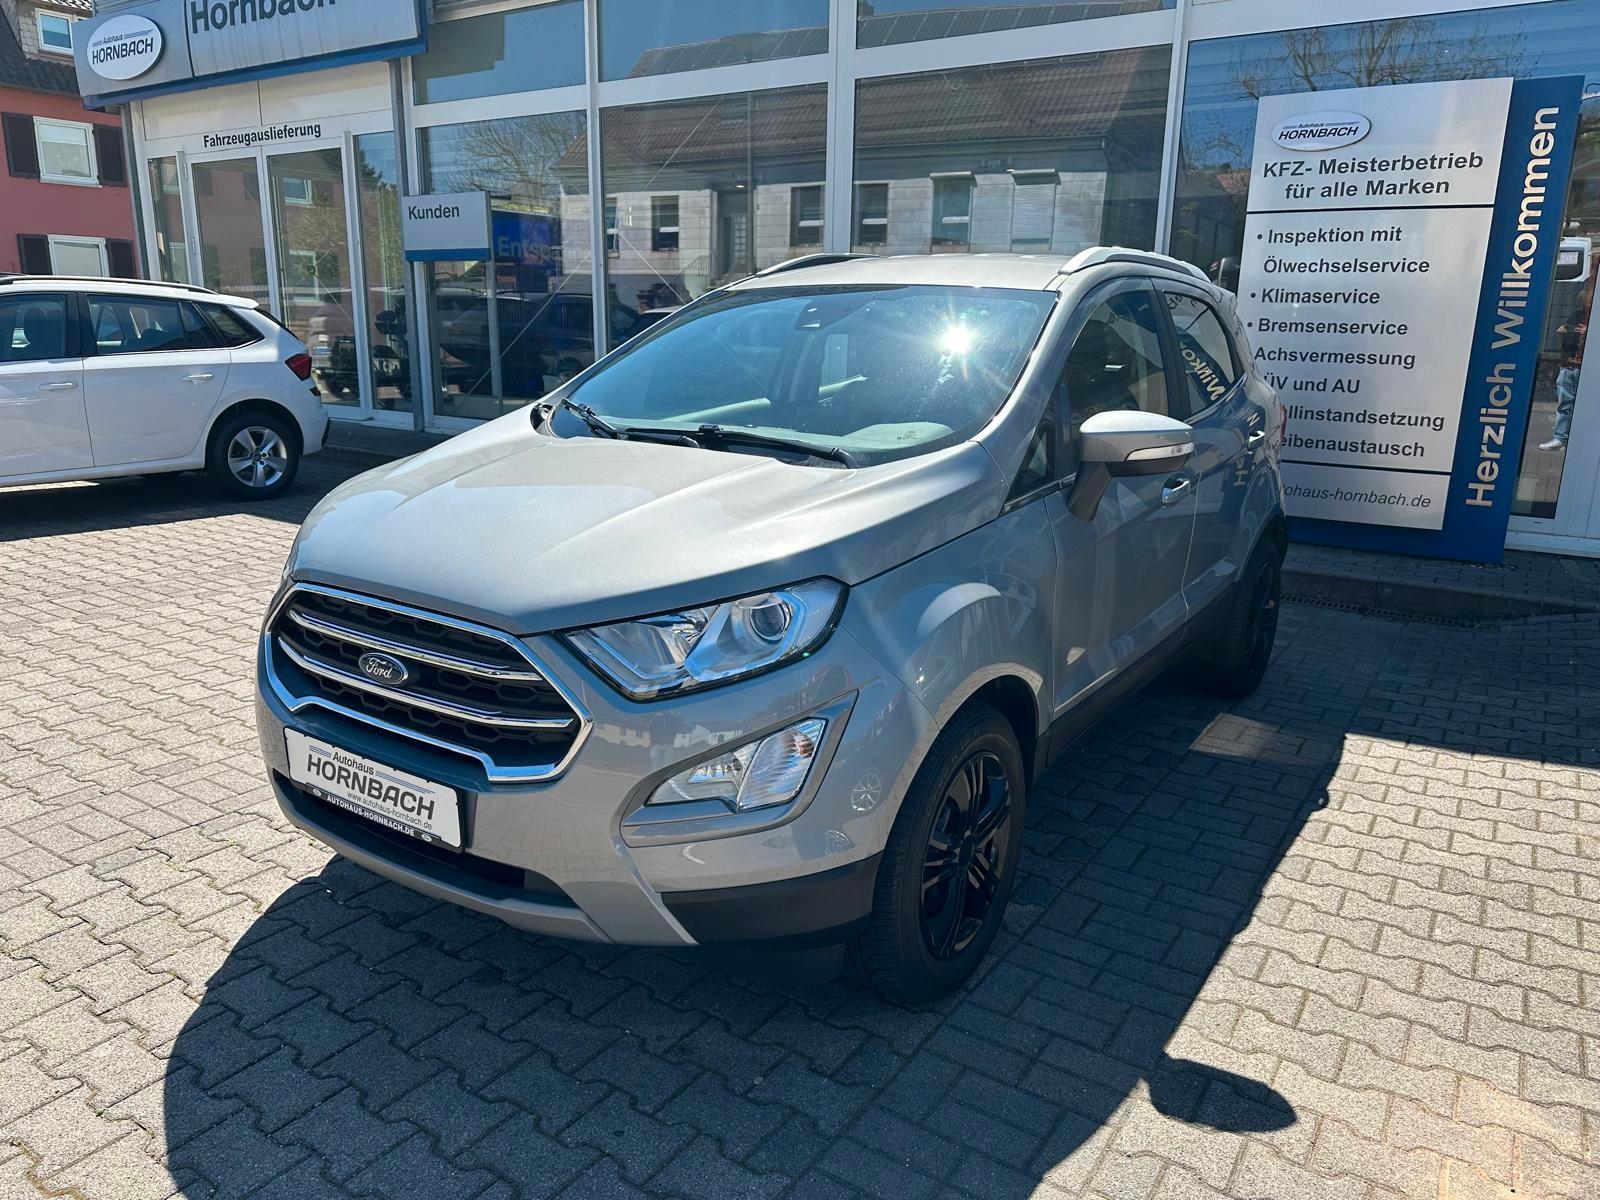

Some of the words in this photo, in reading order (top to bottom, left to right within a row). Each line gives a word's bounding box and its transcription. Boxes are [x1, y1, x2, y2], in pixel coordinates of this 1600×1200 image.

[190, 0, 336, 34] Hornba
[92, 37, 154, 65] HORNBACH
[203, 122, 321, 149] Fahrzeugauslieferung
[1278, 126, 1360, 141] HORNBACH
[1263, 160, 1312, 178] KFZ-
[1318, 151, 1484, 175] Meisterbetrieb
[1285, 183, 1315, 199] für
[1320, 181, 1358, 198] alle
[1365, 178, 1450, 196] Marken
[408, 204, 460, 220] Kunden
[1268, 227, 1364, 247] Inspektion
[1370, 226, 1403, 243] mit
[1491, 106, 1560, 349] Willkommen
[1263, 255, 1430, 274] Ölwechselservice
[1261, 287, 1380, 304] Klimaservice
[1257, 317, 1409, 335] Bremsenservice
[1253, 346, 1416, 370] Achsvermessung
[1293, 376, 1328, 393] und
[1332, 379, 1361, 394] AU
[1287, 405, 1445, 431] llinstandsetzung
[1281, 433, 1425, 458] eibenaustausch
[1465, 363, 1517, 508] Herzlich
[1283, 484, 1431, 509] ohaus-hornbach.de
[365, 657, 393, 679] Ford
[332, 751, 375, 775] Autohaus
[307, 754, 436, 820] HORNBACH
[326, 794, 415, 836] AUTOHAUS-HORNBACH.DE
[347, 792, 433, 831] www.autohaus-hornbach.de
